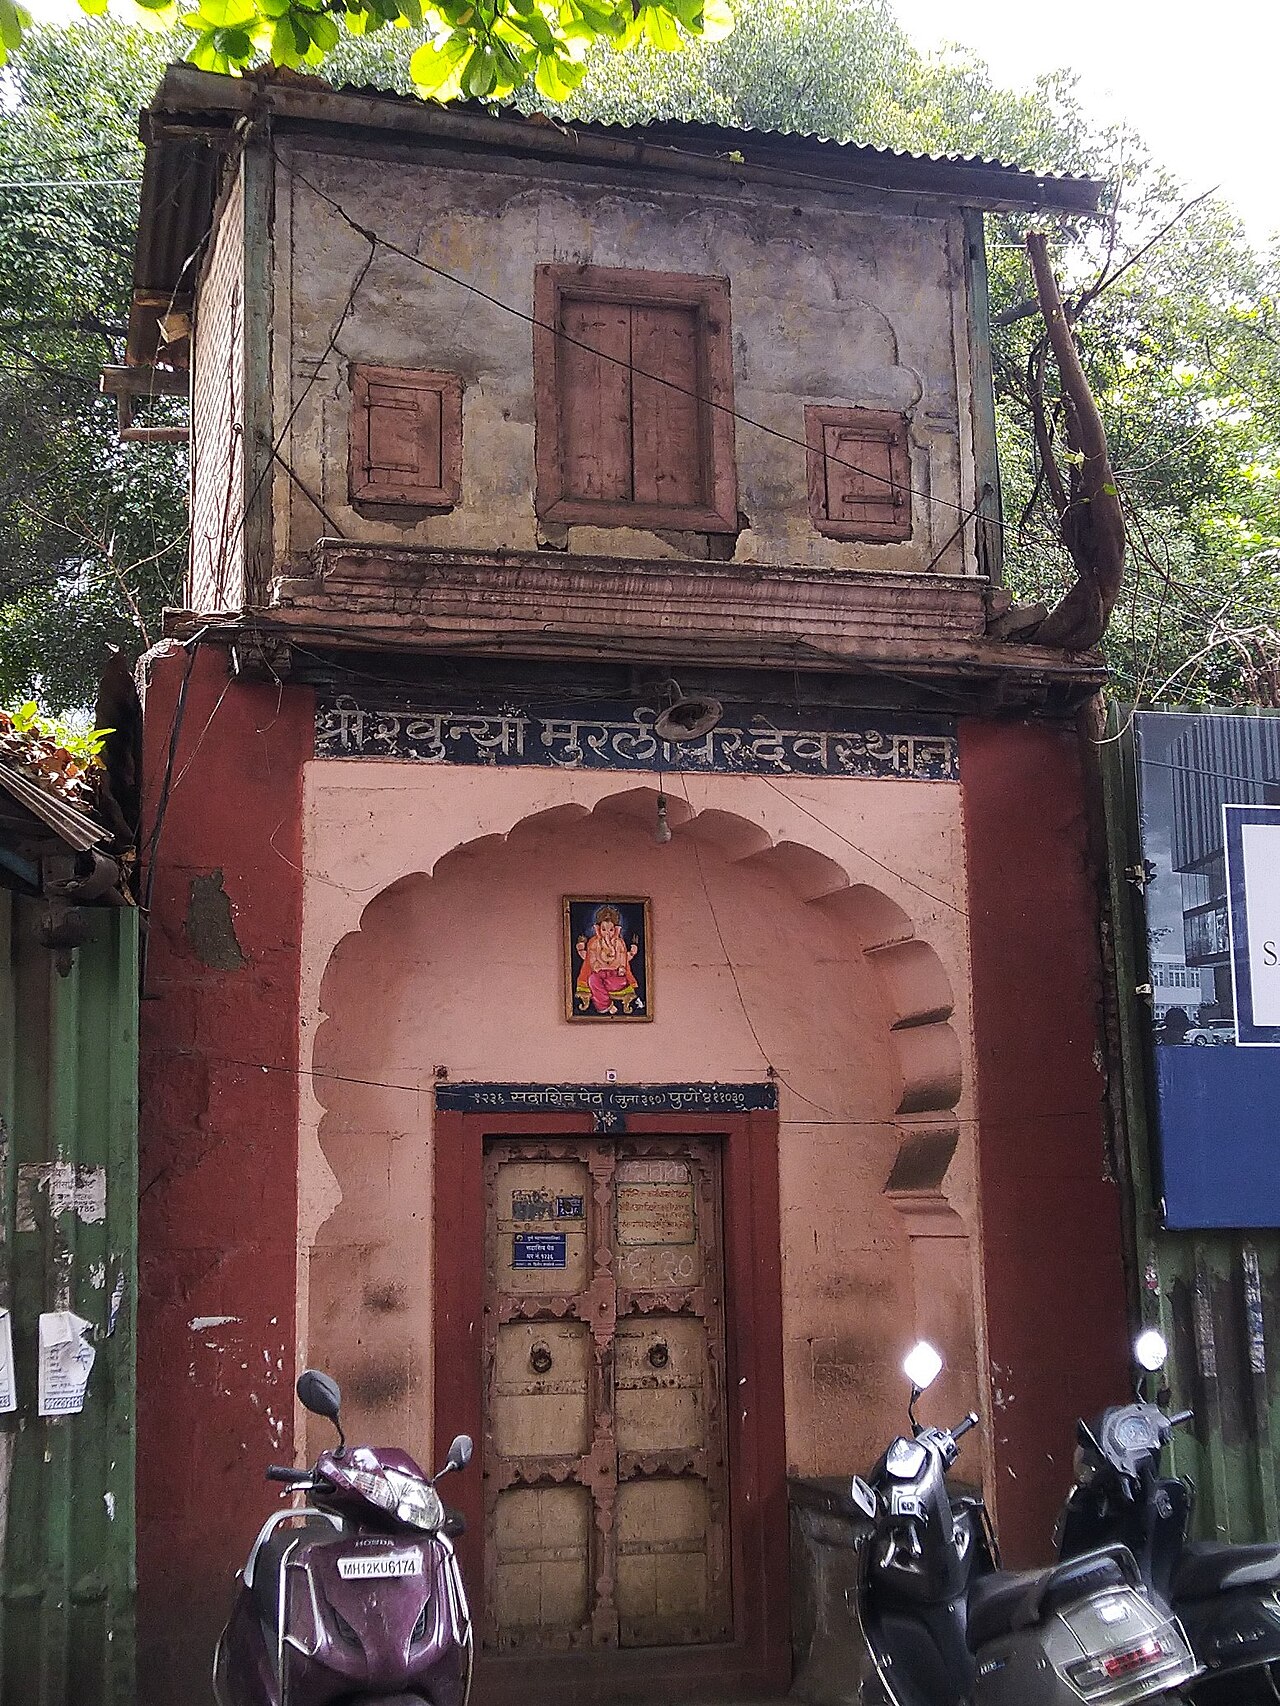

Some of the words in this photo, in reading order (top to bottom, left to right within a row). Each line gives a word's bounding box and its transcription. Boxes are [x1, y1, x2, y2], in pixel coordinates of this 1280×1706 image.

[1263, 941, 1280, 966] S
[510, 1087, 576, 1106] सदाशिव
[577, 1087, 604, 1104] पेठ
[668, 1087, 701, 1110] पुणे
[343, 1560, 415, 1575] MH12KU6174
